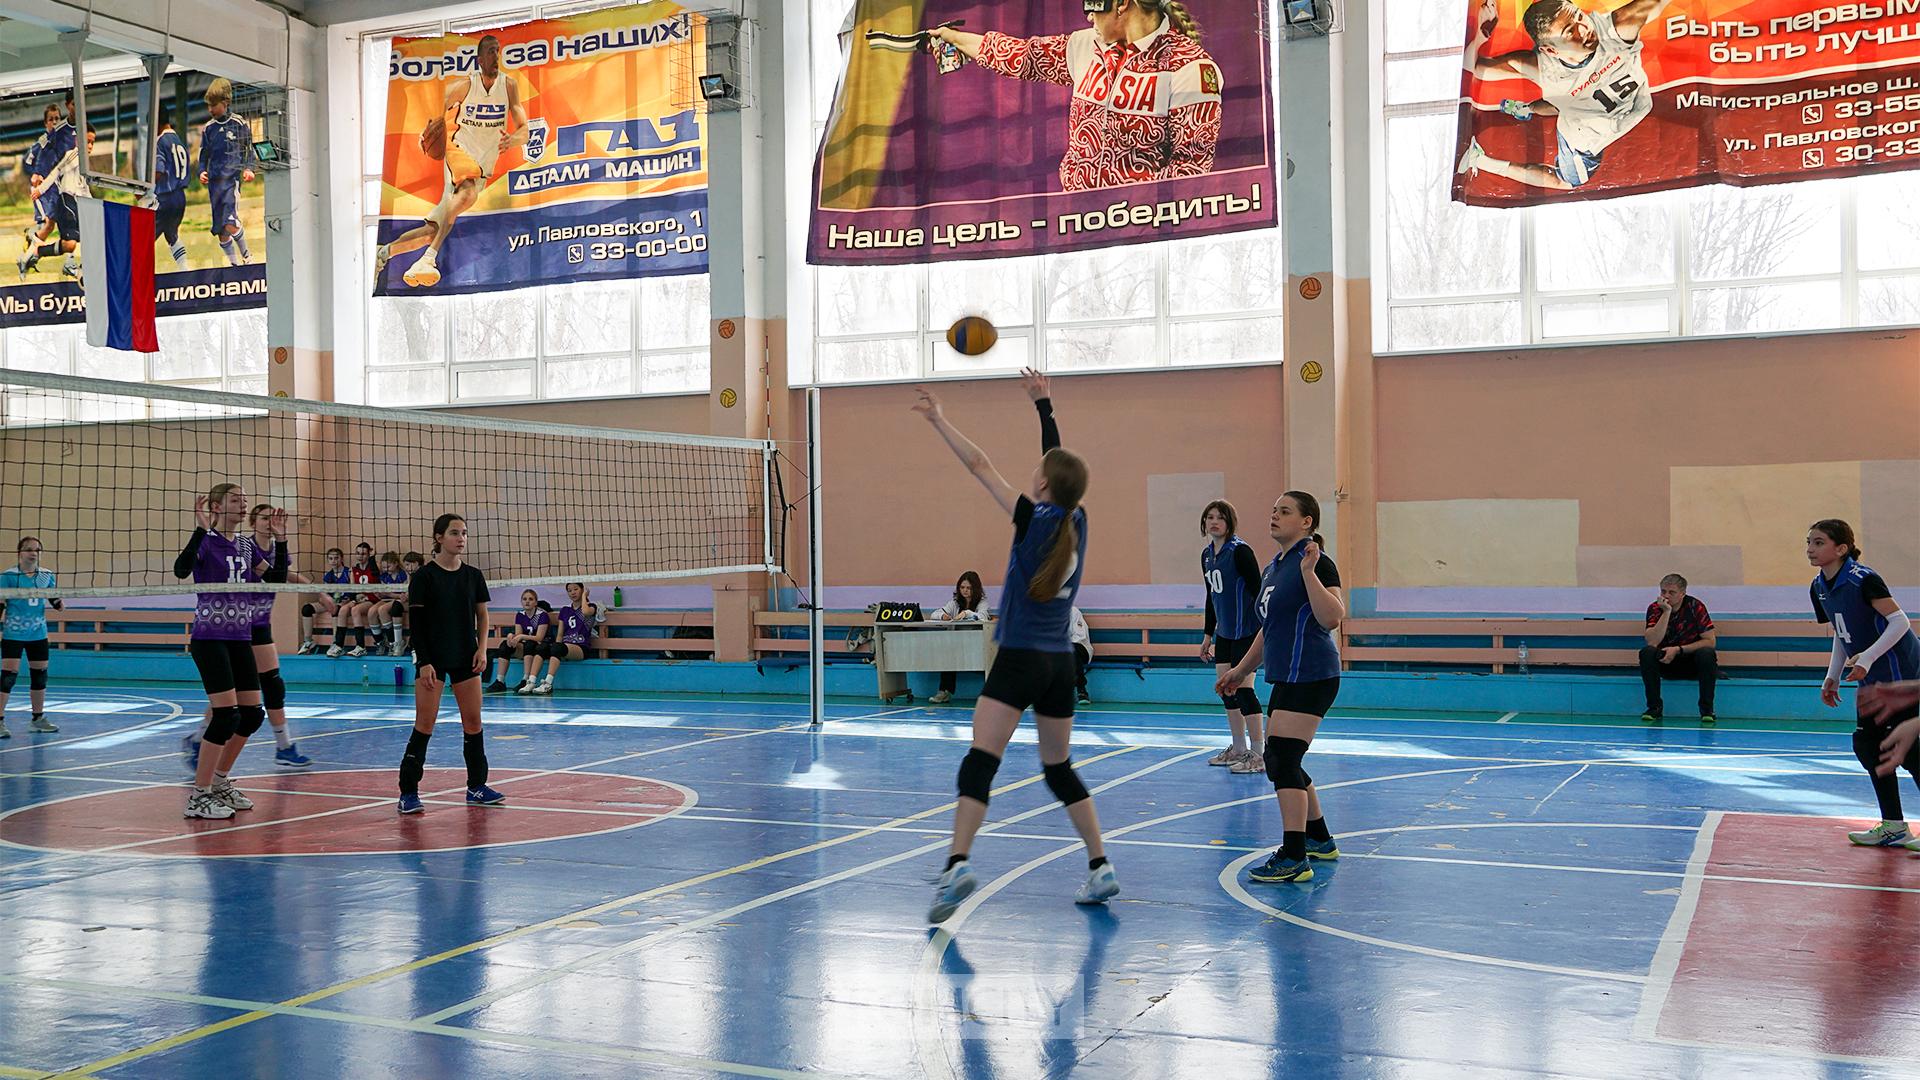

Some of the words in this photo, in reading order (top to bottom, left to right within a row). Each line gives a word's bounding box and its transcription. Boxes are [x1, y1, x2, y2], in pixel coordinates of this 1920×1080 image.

[505, 43, 547, 65] за
[557, 13, 689, 57] наших!
[1666, 15, 1760, 40] Быть
[1709, 41, 1807, 63] быть
[1592, 74, 1640, 113] 15
[1676, 81, 1879, 110] Магистральное
[1886, 77, 1919, 91] ш.
[557, 109, 700, 157] ГАЗ
[1723, 138, 1758, 153] ул.
[171, 143, 188, 181] 19
[513, 163, 590, 190] ДЕТАЛИ
[605, 151, 693, 178] МАШИН
[508, 234, 534, 252] ул.
[538, 217, 684, 243] Павловского,
[689, 210, 702, 227] 1
[828, 224, 925, 249] Наша
[932, 220, 1021, 248] цель
[1058, 184, 1262, 234] победить!
[590, 234, 707, 259] 33-00-00
[0, 296, 34, 314] Мы
[226, 556, 247, 584] 12
[1205, 569, 1224, 594] 10
[1259, 585, 1276, 619] 5
[568, 615, 577, 629] 6
[1834, 612, 1852, 644] 4
